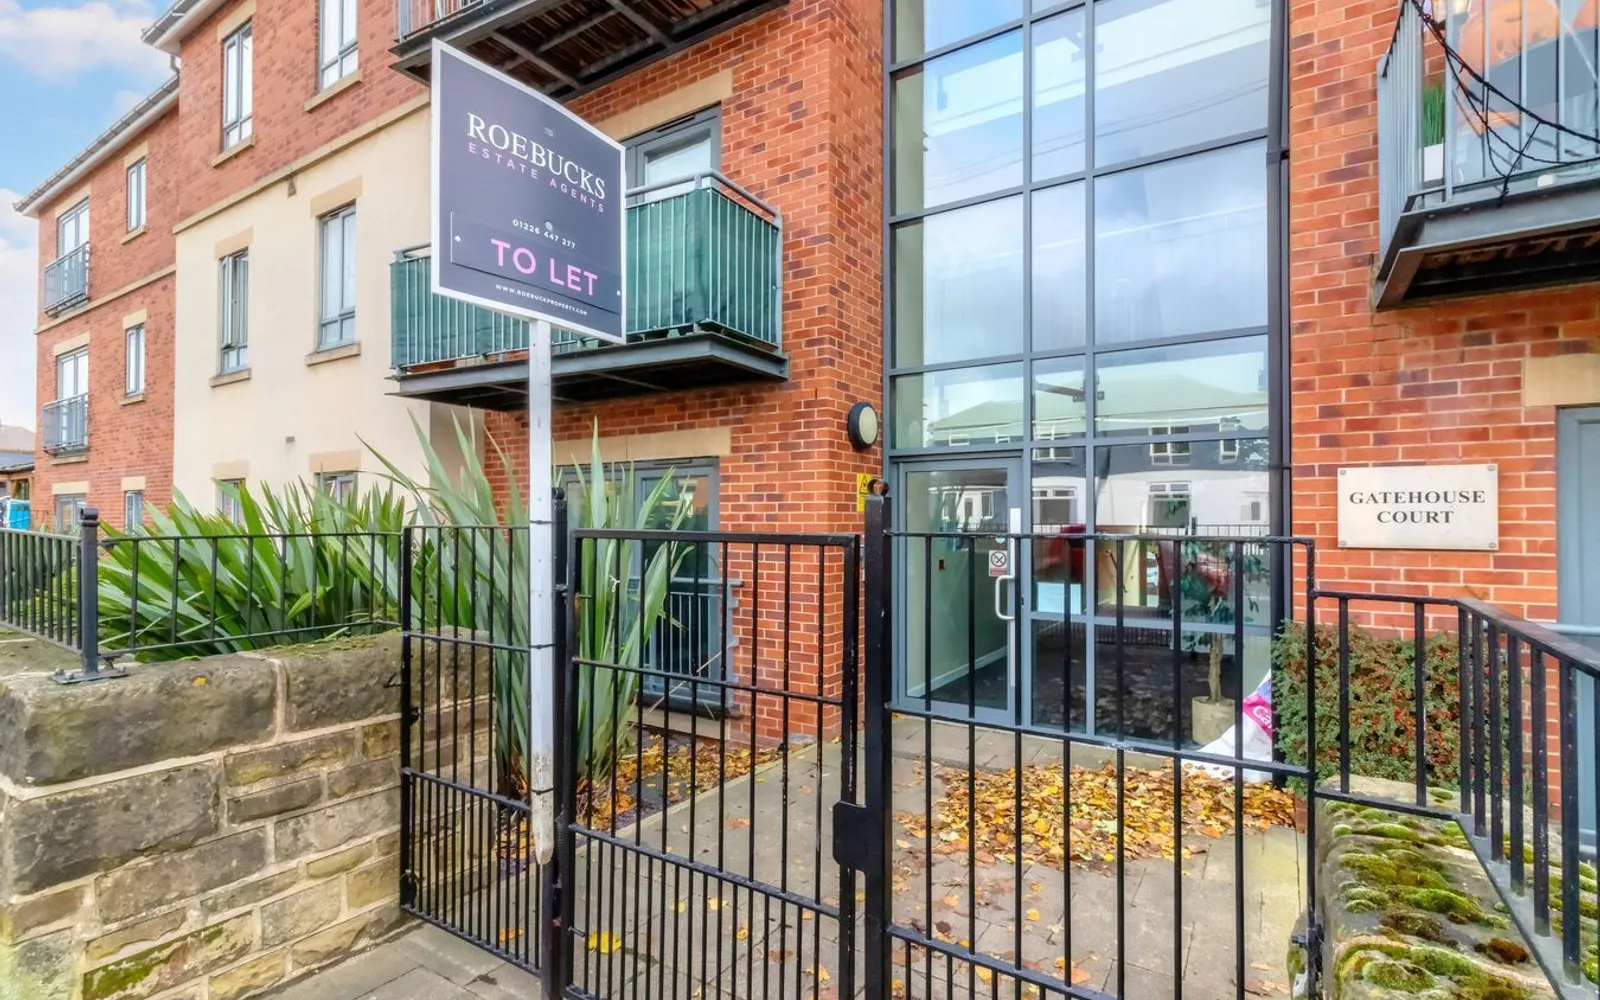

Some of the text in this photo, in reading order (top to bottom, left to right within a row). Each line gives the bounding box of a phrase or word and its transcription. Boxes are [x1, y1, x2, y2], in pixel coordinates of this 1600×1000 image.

[467, 112, 606, 200] ROEBUCKS
[468, 142, 604, 213] ESTATE AGENTS
[512, 219, 576, 249] 01226 447 277
[490, 238, 598, 296] TO LET
[1349, 490, 1486, 504] GATEHOUSE
[1377, 510, 1455, 524] COURT
